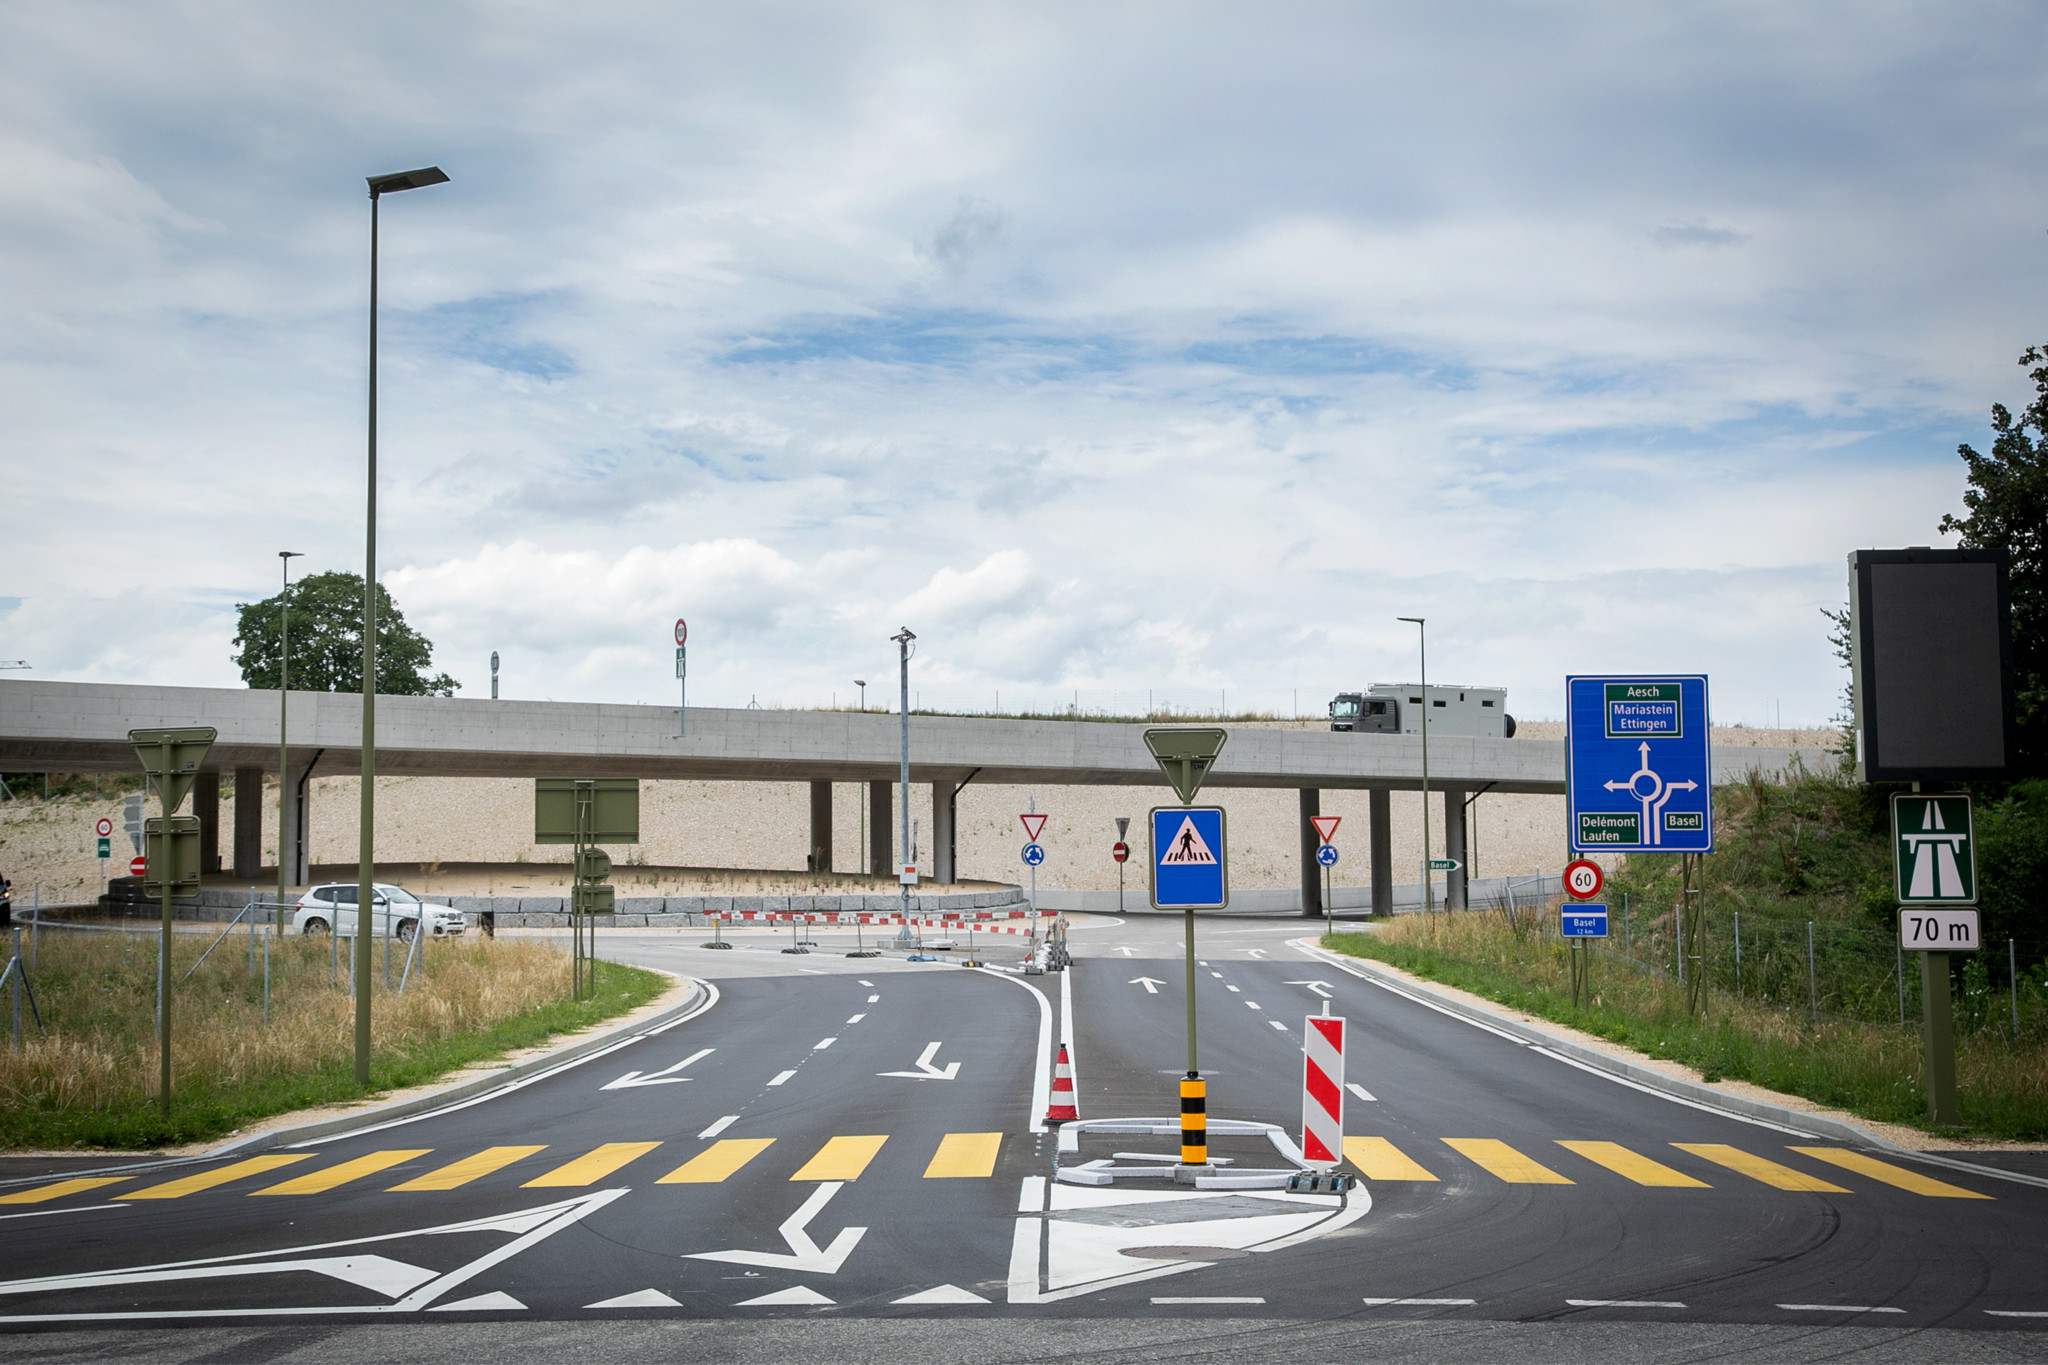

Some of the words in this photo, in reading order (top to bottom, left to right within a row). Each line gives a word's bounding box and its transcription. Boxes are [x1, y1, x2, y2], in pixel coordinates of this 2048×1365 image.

[1627, 686, 1659, 697] Aesch
[1614, 704, 1672, 715] Mariastein
[1621, 718, 1667, 731] Ettingen
[1582, 816, 1635, 827] Delémont
[1669, 815, 1699, 826] Basel
[1583, 830, 1620, 841] Laufen
[1575, 873, 1591, 887] 60
[1573, 918, 1596, 927] Basel
[1910, 917, 1939, 941] 70
[1949, 922, 1969, 941] m
